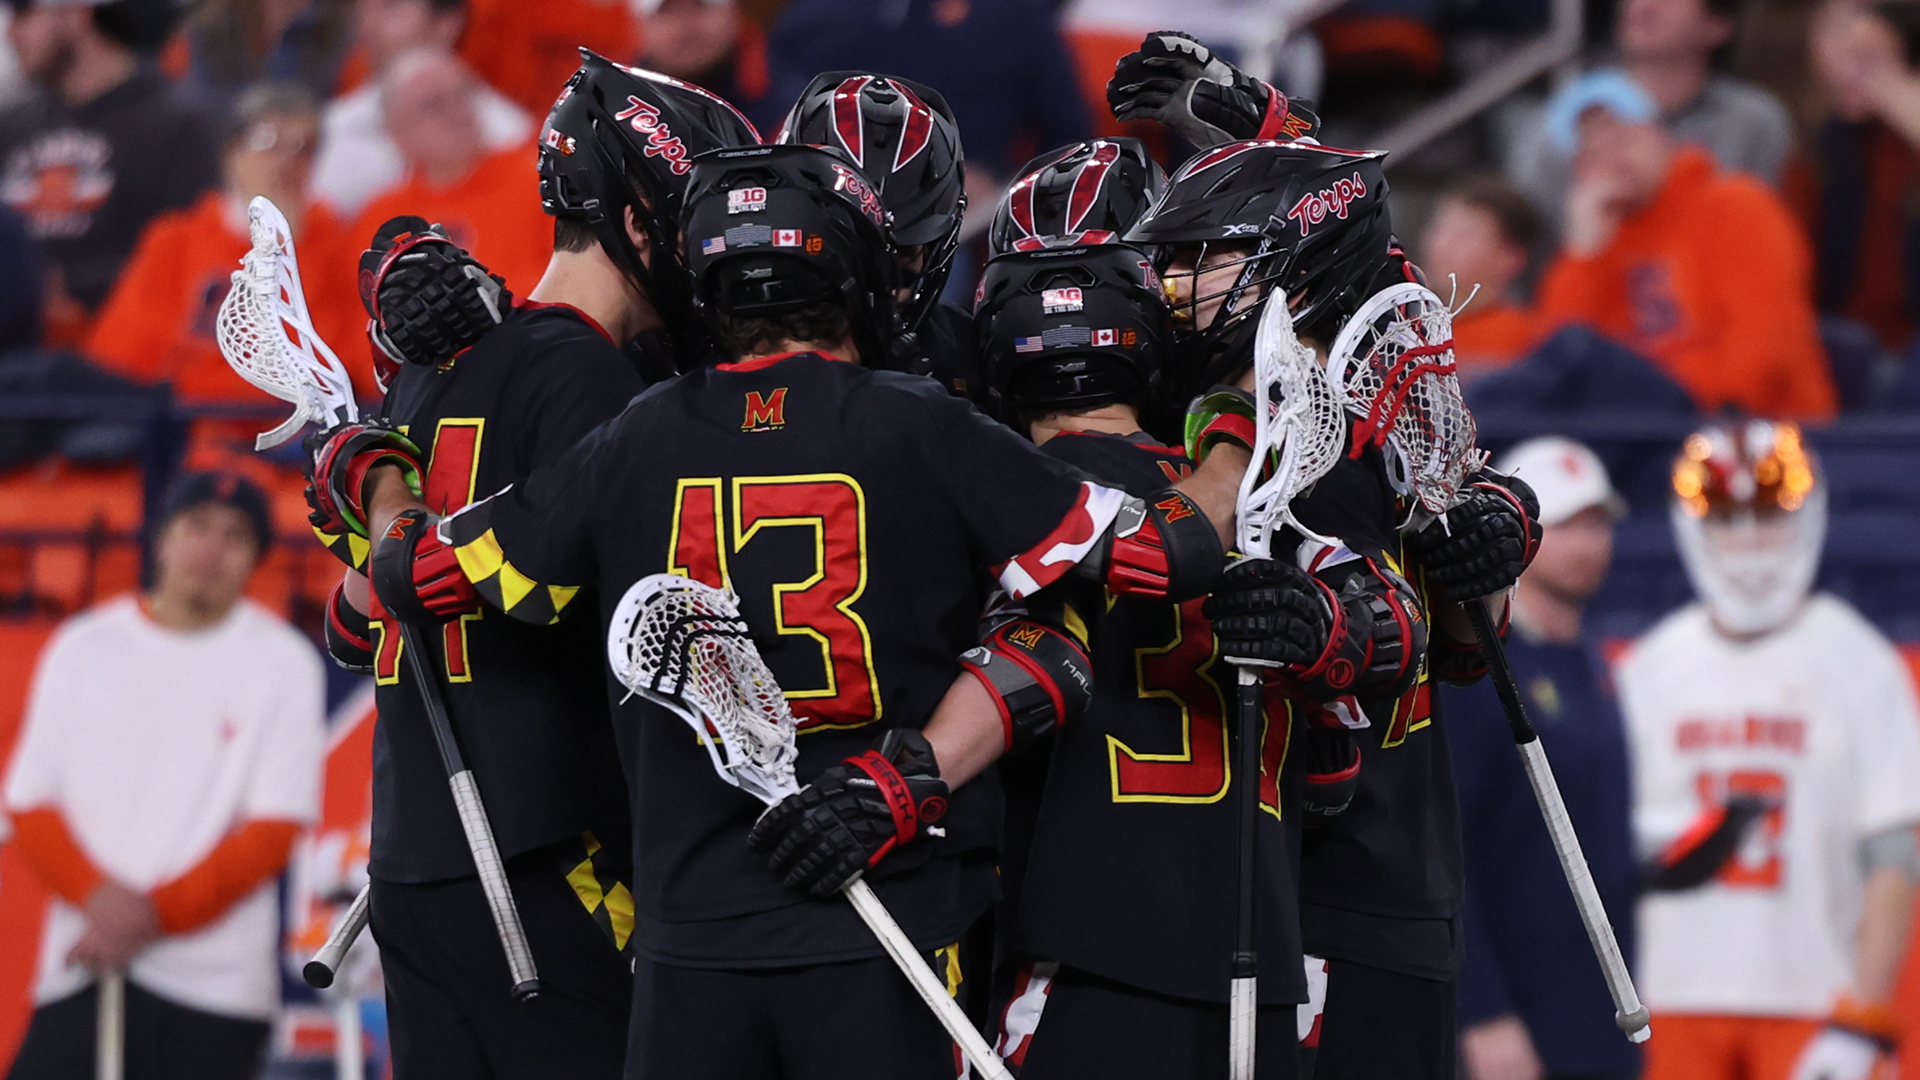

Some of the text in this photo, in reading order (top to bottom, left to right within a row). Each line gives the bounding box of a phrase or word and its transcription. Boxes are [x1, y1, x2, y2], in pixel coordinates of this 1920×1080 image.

[615, 95, 693, 175] Terps
[1287, 171, 1367, 237] Terps
[741, 388, 788, 428] M
[1155, 495, 1192, 524] M
[668, 473, 882, 745] 13
[1010, 624, 1046, 648] M
